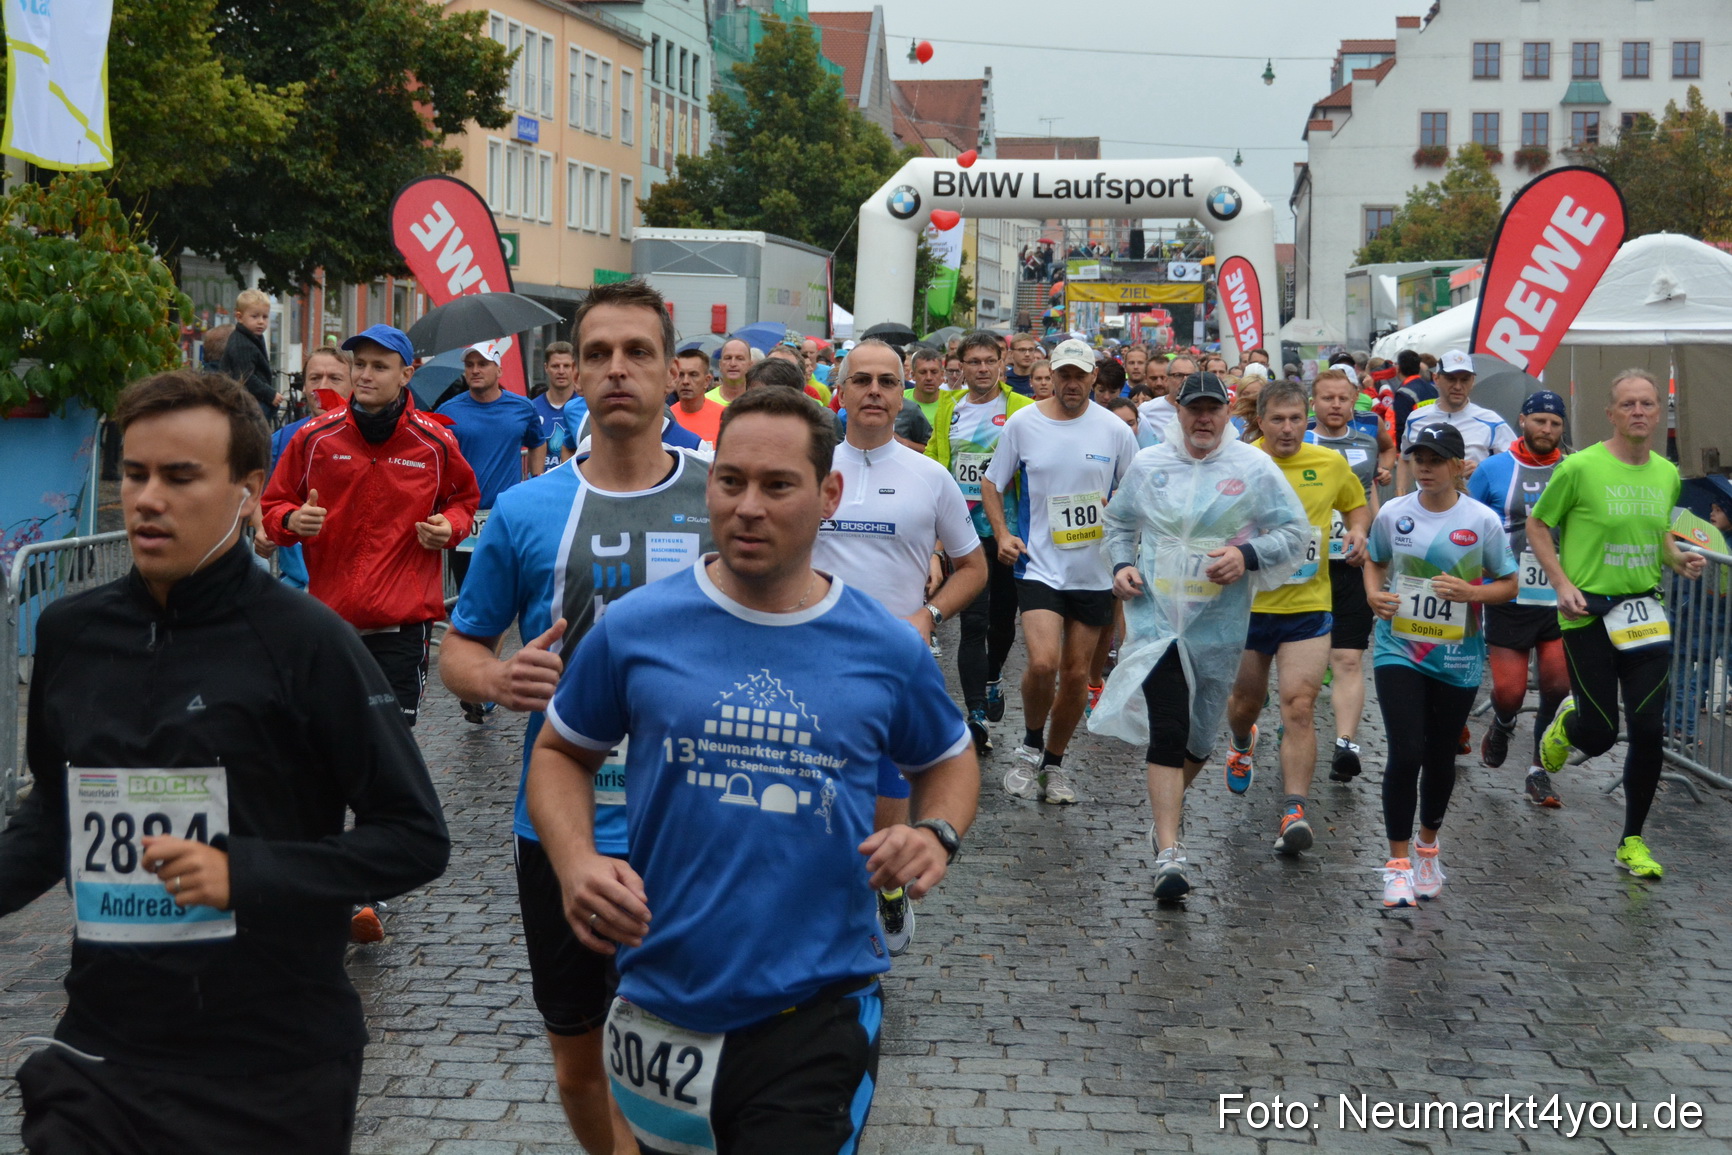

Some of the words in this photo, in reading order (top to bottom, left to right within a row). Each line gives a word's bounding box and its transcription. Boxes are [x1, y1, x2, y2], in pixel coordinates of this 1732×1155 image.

[932, 170, 1024, 199] BMW
[1032, 172, 1194, 205] Laufsport
[1484, 194, 1606, 370] REWE
[1120, 287, 1152, 300] ZIEL
[402, 459, 427, 469] DEINING
[1605, 485, 1666, 501] NOVINA
[1061, 504, 1098, 528] 180
[1607, 502, 1666, 518] HOTELS
[840, 521, 893, 533] BÜSCHEL
[1066, 530, 1097, 542] Gerhard
[1410, 593, 1453, 622] 104
[1623, 600, 1649, 624] 20
[1411, 622, 1444, 637] Sophia
[1626, 627, 1659, 640] Thomas
[1445, 644, 1461, 655] 17.
[663, 736, 704, 765] 13.
[698, 738, 788, 761] Neumarkter
[798, 766, 823, 780] 2012
[128, 775, 211, 796] BOCK
[100, 891, 188, 917] Andreas
[608, 1020, 704, 1106] 3042
